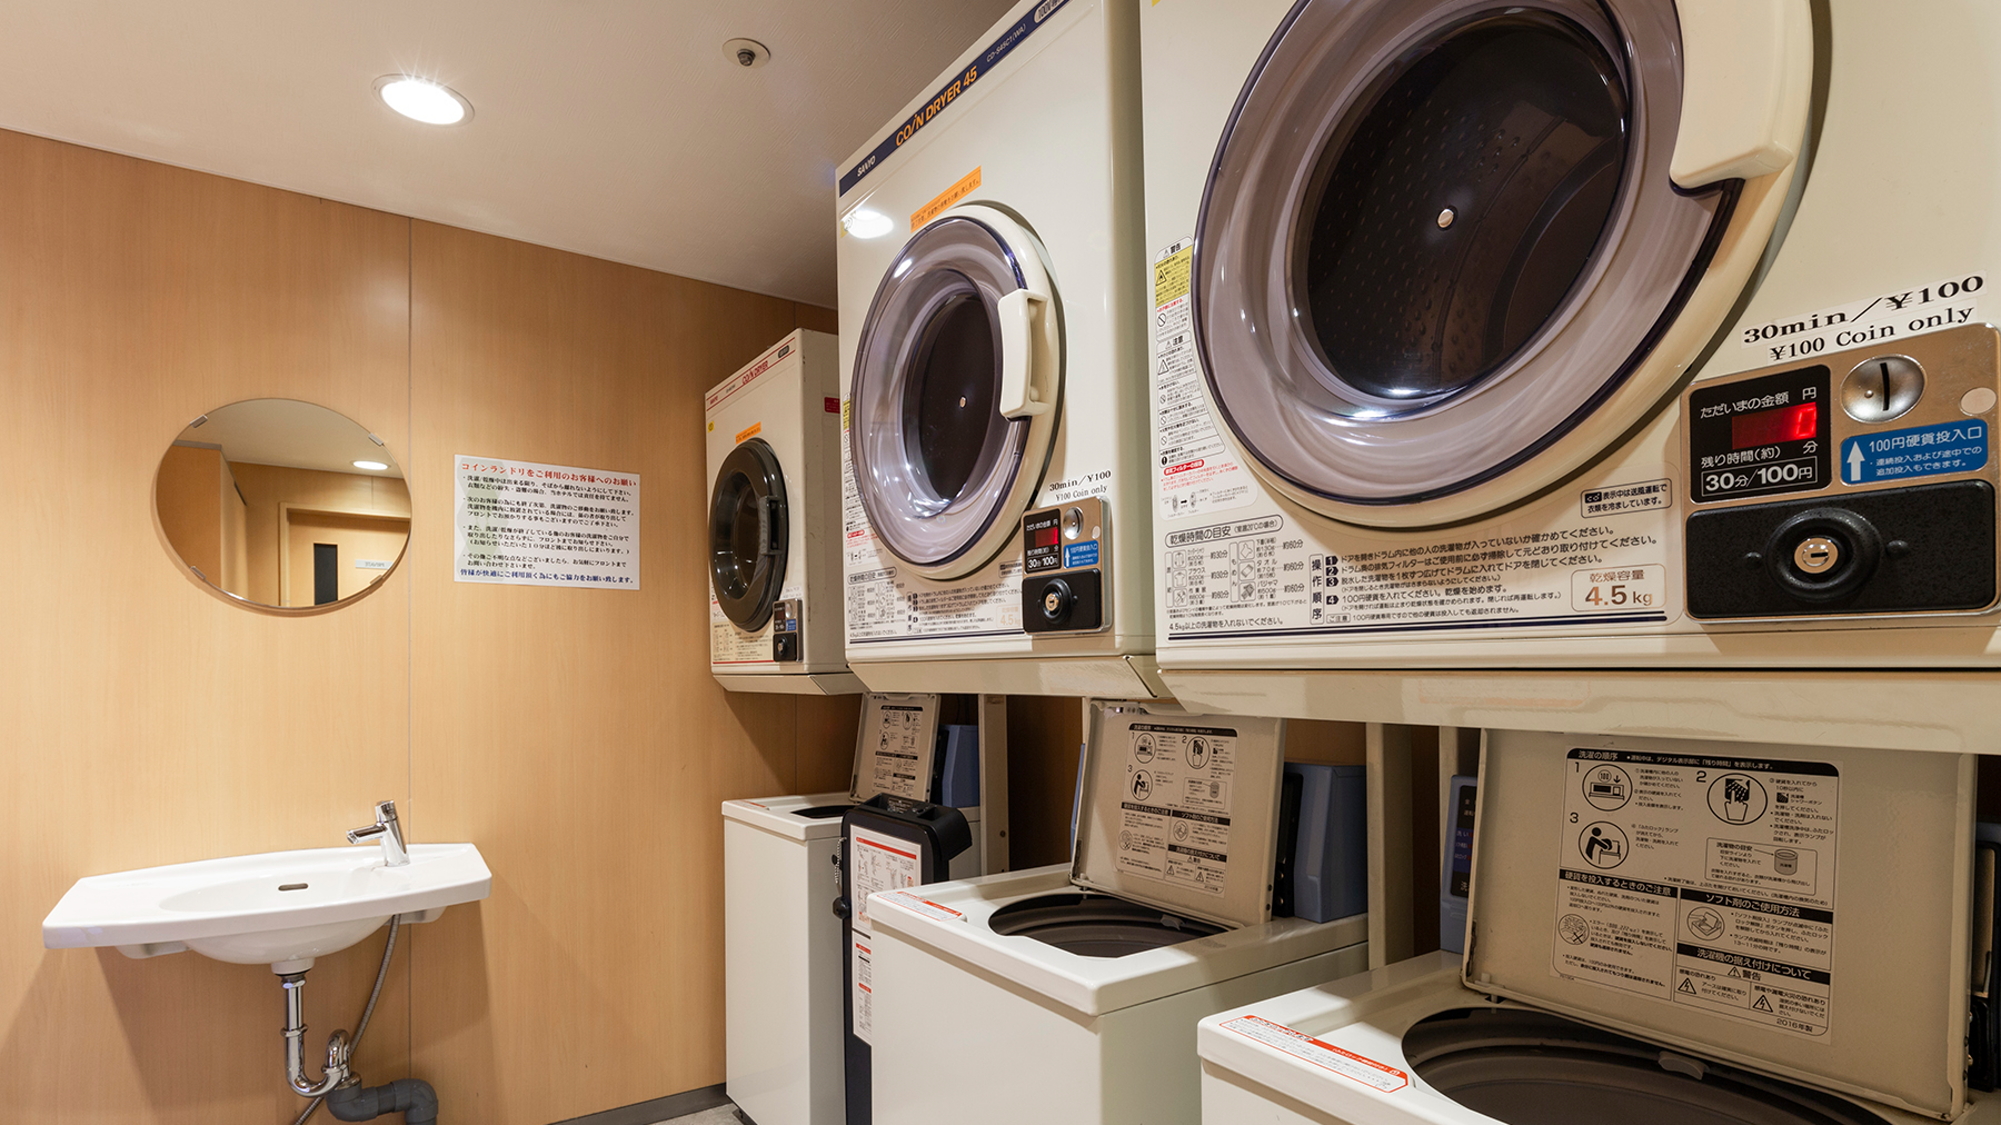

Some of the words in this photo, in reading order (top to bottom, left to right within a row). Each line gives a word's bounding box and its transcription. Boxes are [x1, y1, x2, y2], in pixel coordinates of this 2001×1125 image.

[857, 156, 876, 177] SANYO
[926, 80, 961, 120] DRYER
[964, 66, 978, 86] 45
[1770, 338, 1825, 361] ¥100
[1836, 327, 1895, 347] Coin
[1908, 306, 1974, 332] only
[1701, 391, 1789, 419] ただいまの金額
[1802, 387, 1817, 400] 円
[1803, 440, 1818, 454] 分
[1869, 426, 1982, 453] 100円硬貨投入口
[1705, 464, 1813, 490] 30分/100円
[1073, 489, 1088, 498] Coin
[1091, 485, 1108, 495] only
[1588, 499, 1662, 513] 衣類を冷ましています。
[1170, 526, 1231, 544] 乾燥時間の目安
[1589, 570, 1645, 583] 乾燥容量
[1585, 585, 1627, 606] 4.5
[1633, 590, 1653, 605] kg
[1578, 750, 1618, 760] 洗濯の順序
[1574, 762, 1579, 772] 1
[1696, 771, 1707, 782] 2
[1569, 812, 1579, 823] 3
[1565, 872, 1671, 896] 硬貨を投入するときのご注意
[1706, 894, 1800, 917] ソフト剤のご使用方法
[1742, 970, 1761, 981] 警告
[1776, 1018, 1813, 1032] 2016年製
